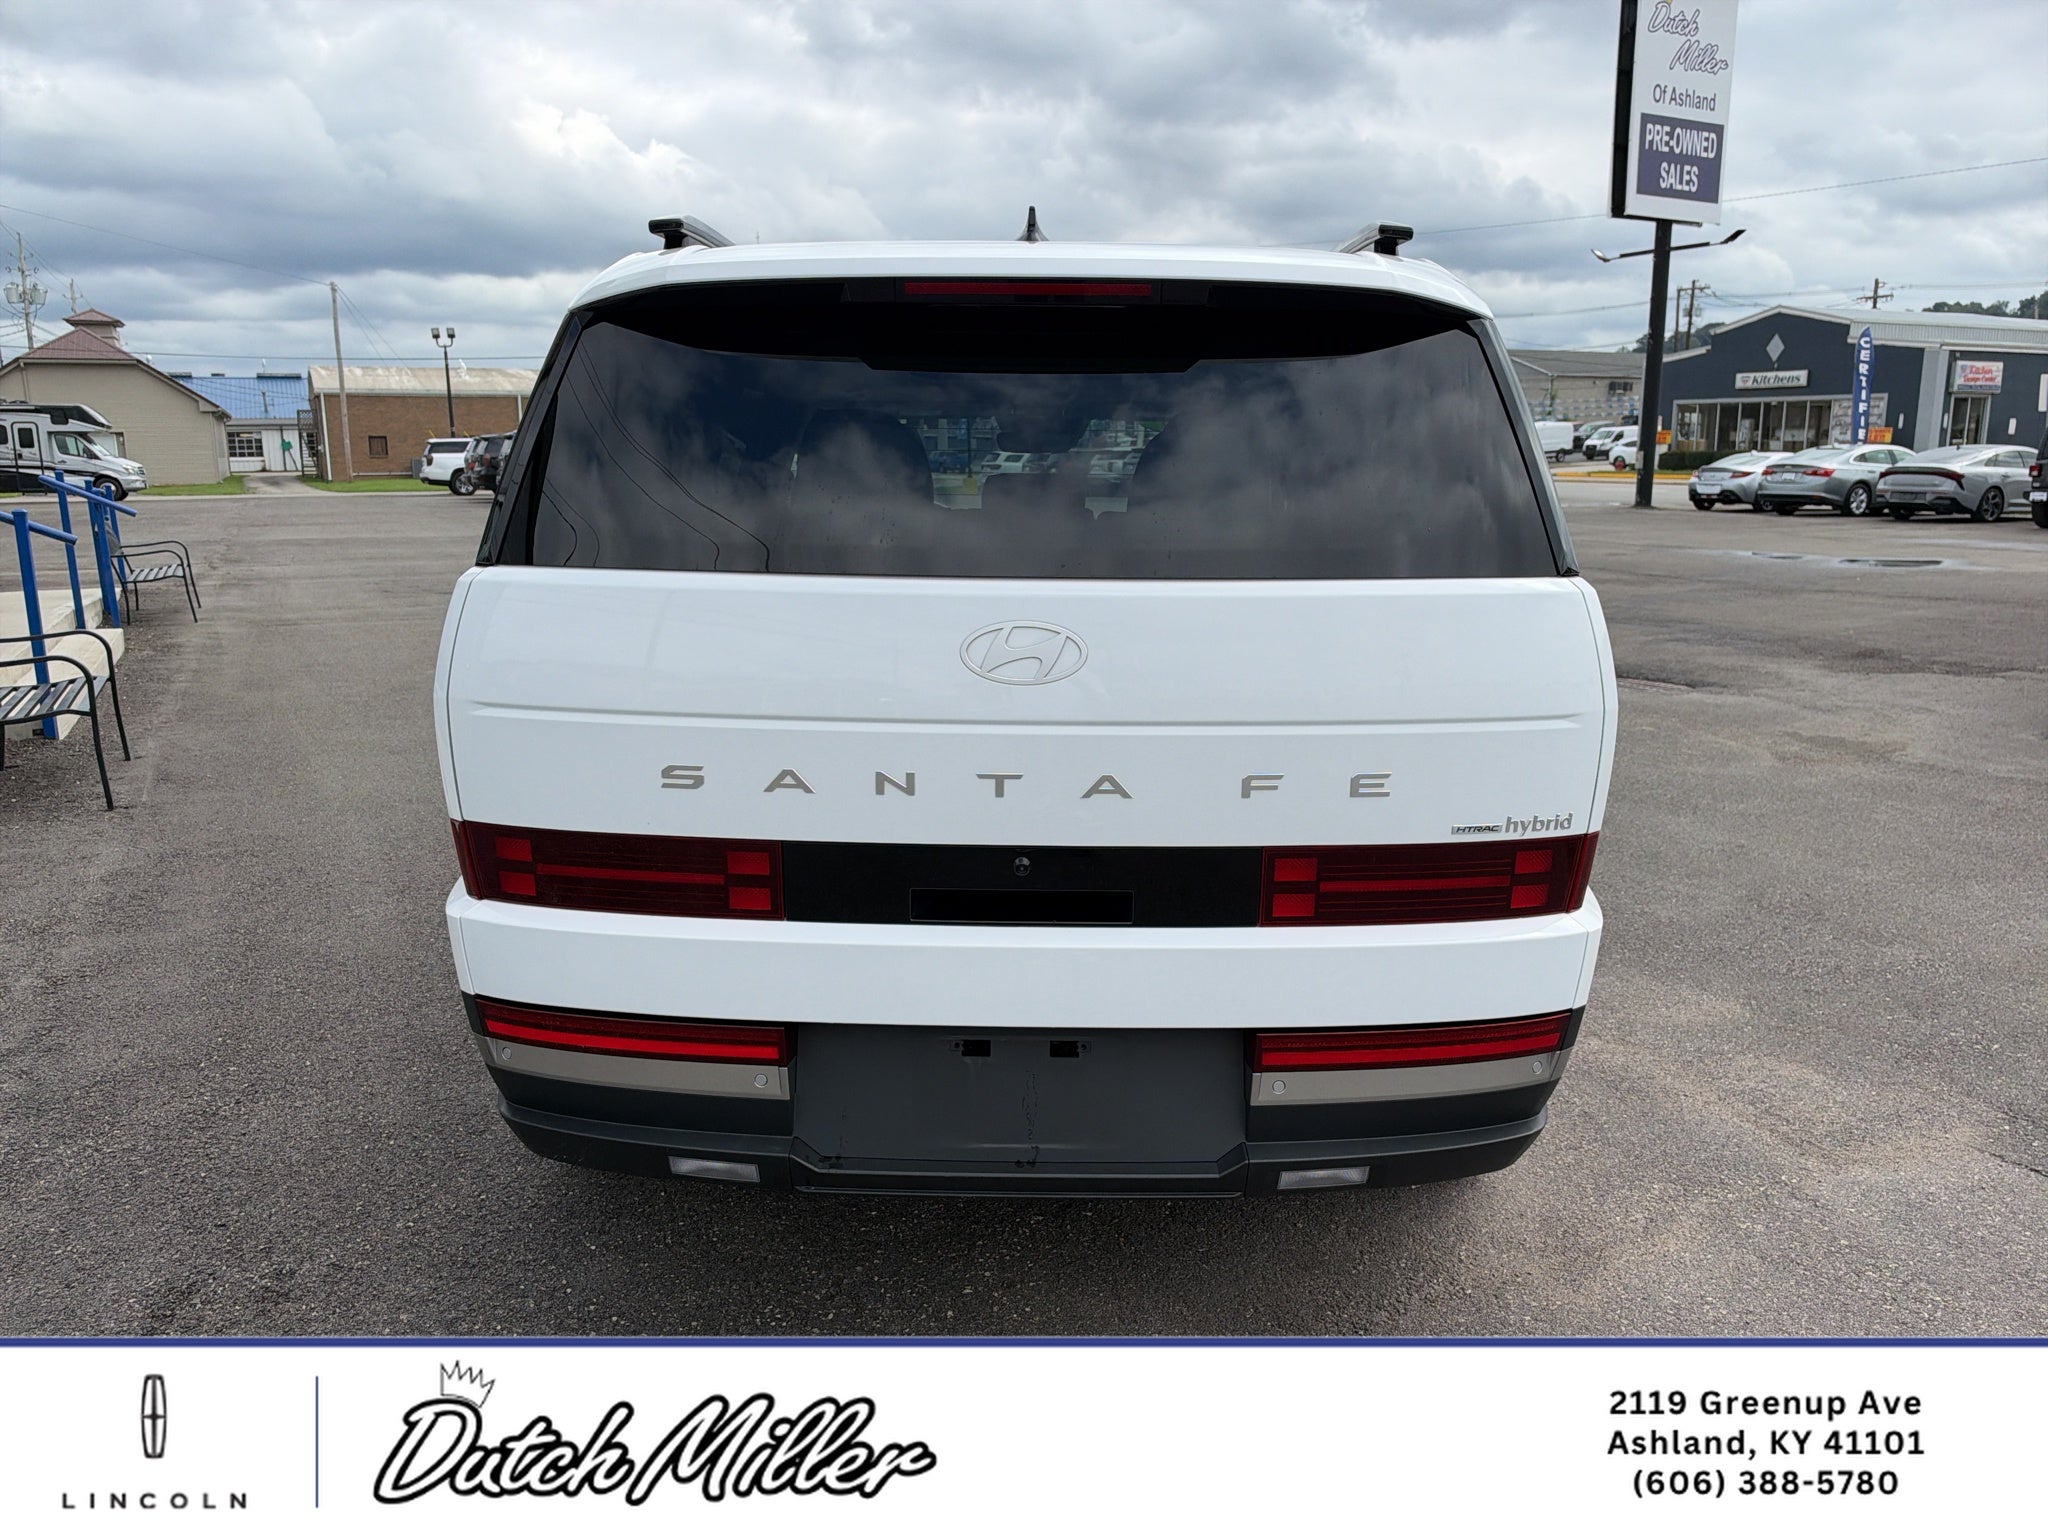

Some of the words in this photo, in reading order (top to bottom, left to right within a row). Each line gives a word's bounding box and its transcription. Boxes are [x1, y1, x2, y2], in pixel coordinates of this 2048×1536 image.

[1648, 1, 1700, 37] Dutch
[1669, 39, 1728, 75] Miller
[1653, 84, 1667, 104] Of
[1669, 87, 1716, 111] Ashland
[1645, 123, 1717, 159] PRE-OWNED
[1659, 162, 1699, 192] SALES
[1752, 374, 1801, 385] Kitchens
[1858, 336, 1871, 446] CERTIFIE
[661, 764, 1134, 799] SANTA
[1241, 772, 1392, 799] FE
[1455, 824, 1501, 834] HTRAC
[1505, 811, 1573, 837] hybrid
